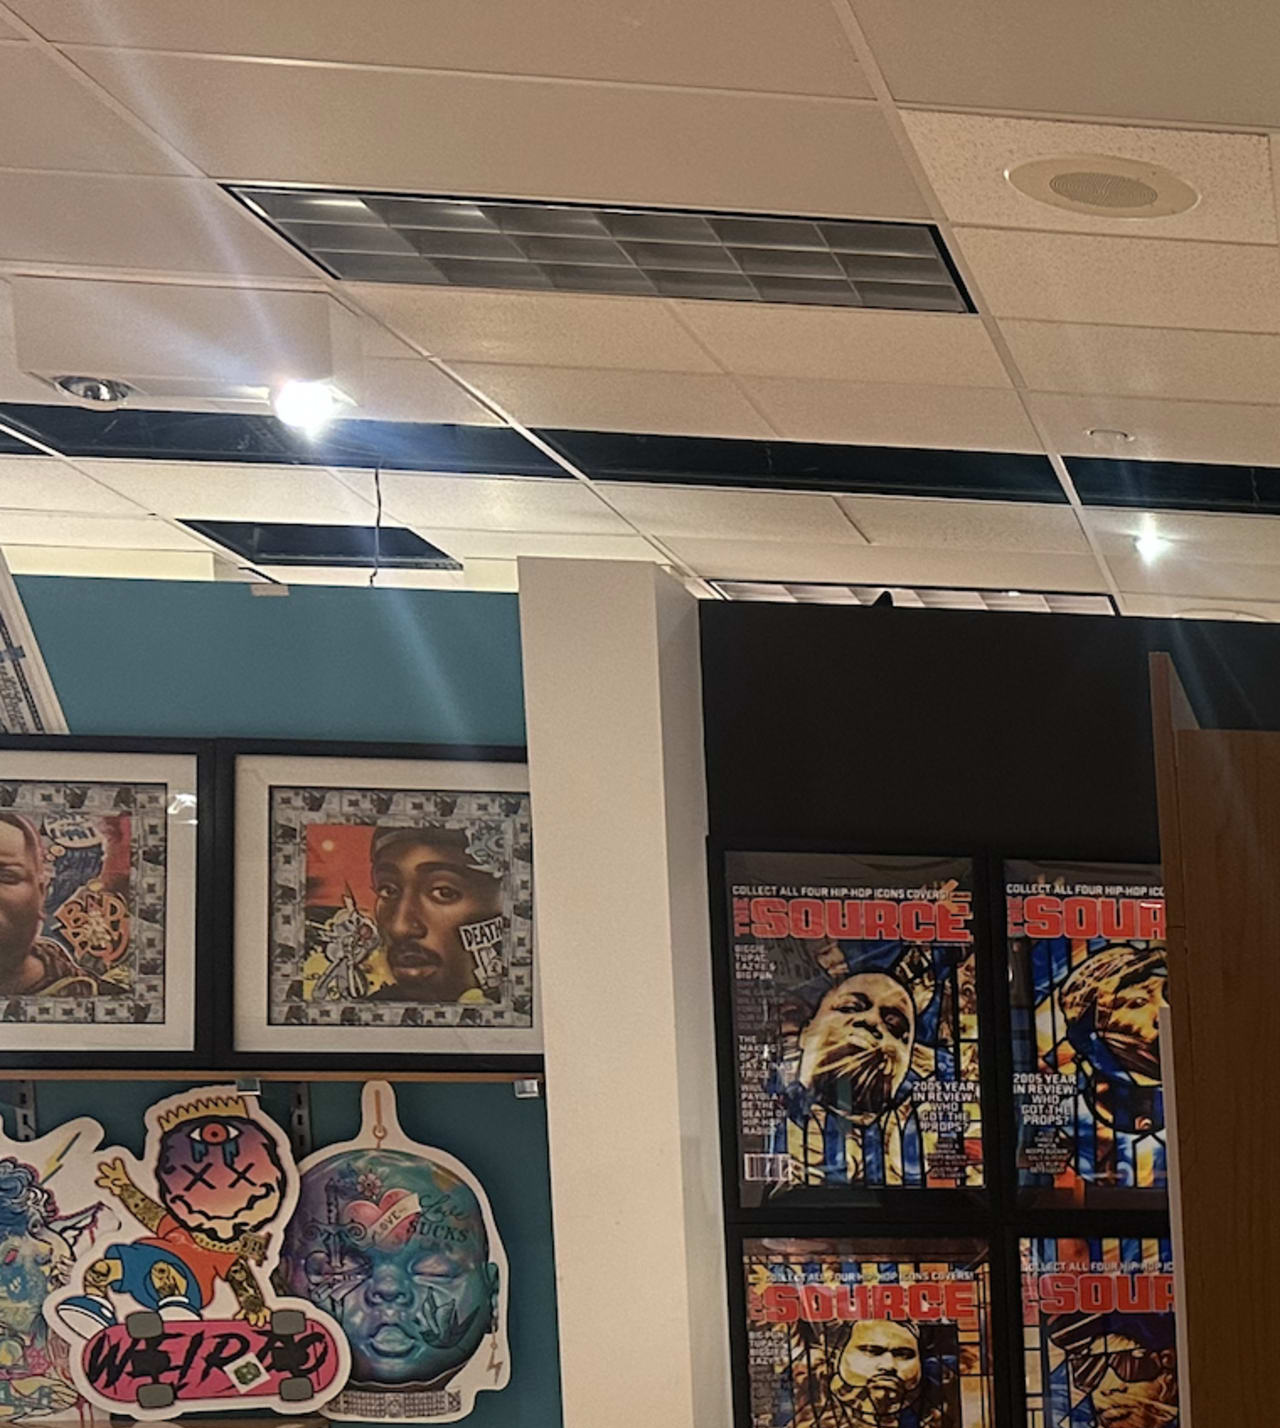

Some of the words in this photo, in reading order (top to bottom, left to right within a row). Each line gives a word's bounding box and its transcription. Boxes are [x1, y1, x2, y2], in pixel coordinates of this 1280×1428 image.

[733, 885, 777, 897] COLLECT
[780, 886, 799, 897] ALL
[801, 887, 828, 897] FOUR
[830, 888, 872, 898] HIP-HOP
[874, 889, 904, 899] ICONS
[1006, 883, 1050, 894] COLLECT
[1054, 884, 1073, 895] ALL
[1075, 884, 1102, 895] FOUR
[1105, 885, 1147, 896] HIP-HOP
[750, 897, 973, 941] SOURCE
[1024, 895, 1166, 940] SOUR
[738, 1035, 756, 1043] THE
[1013, 1073, 1042, 1084] 2005
[1044, 1074, 1077, 1085] YEAR
[913, 1081, 941, 1092] 2005
[944, 1082, 975, 1092] YEAR
[1013, 1084, 1026, 1094] IN
[913, 1091, 925, 1101] IN
[1032, 1095, 1060, 1105] WHO
[1022, 1104, 1044, 1114] GOT
[1048, 1105, 1071, 1115] THE
[1023, 1115, 1070, 1126] PROPS?
[1069, 1262, 1088, 1272] ALL
[1039, 1273, 1176, 1314] SOUR
[764, 1283, 978, 1322] SOURCE
[86, 1330, 328, 1392] WEIRDO
